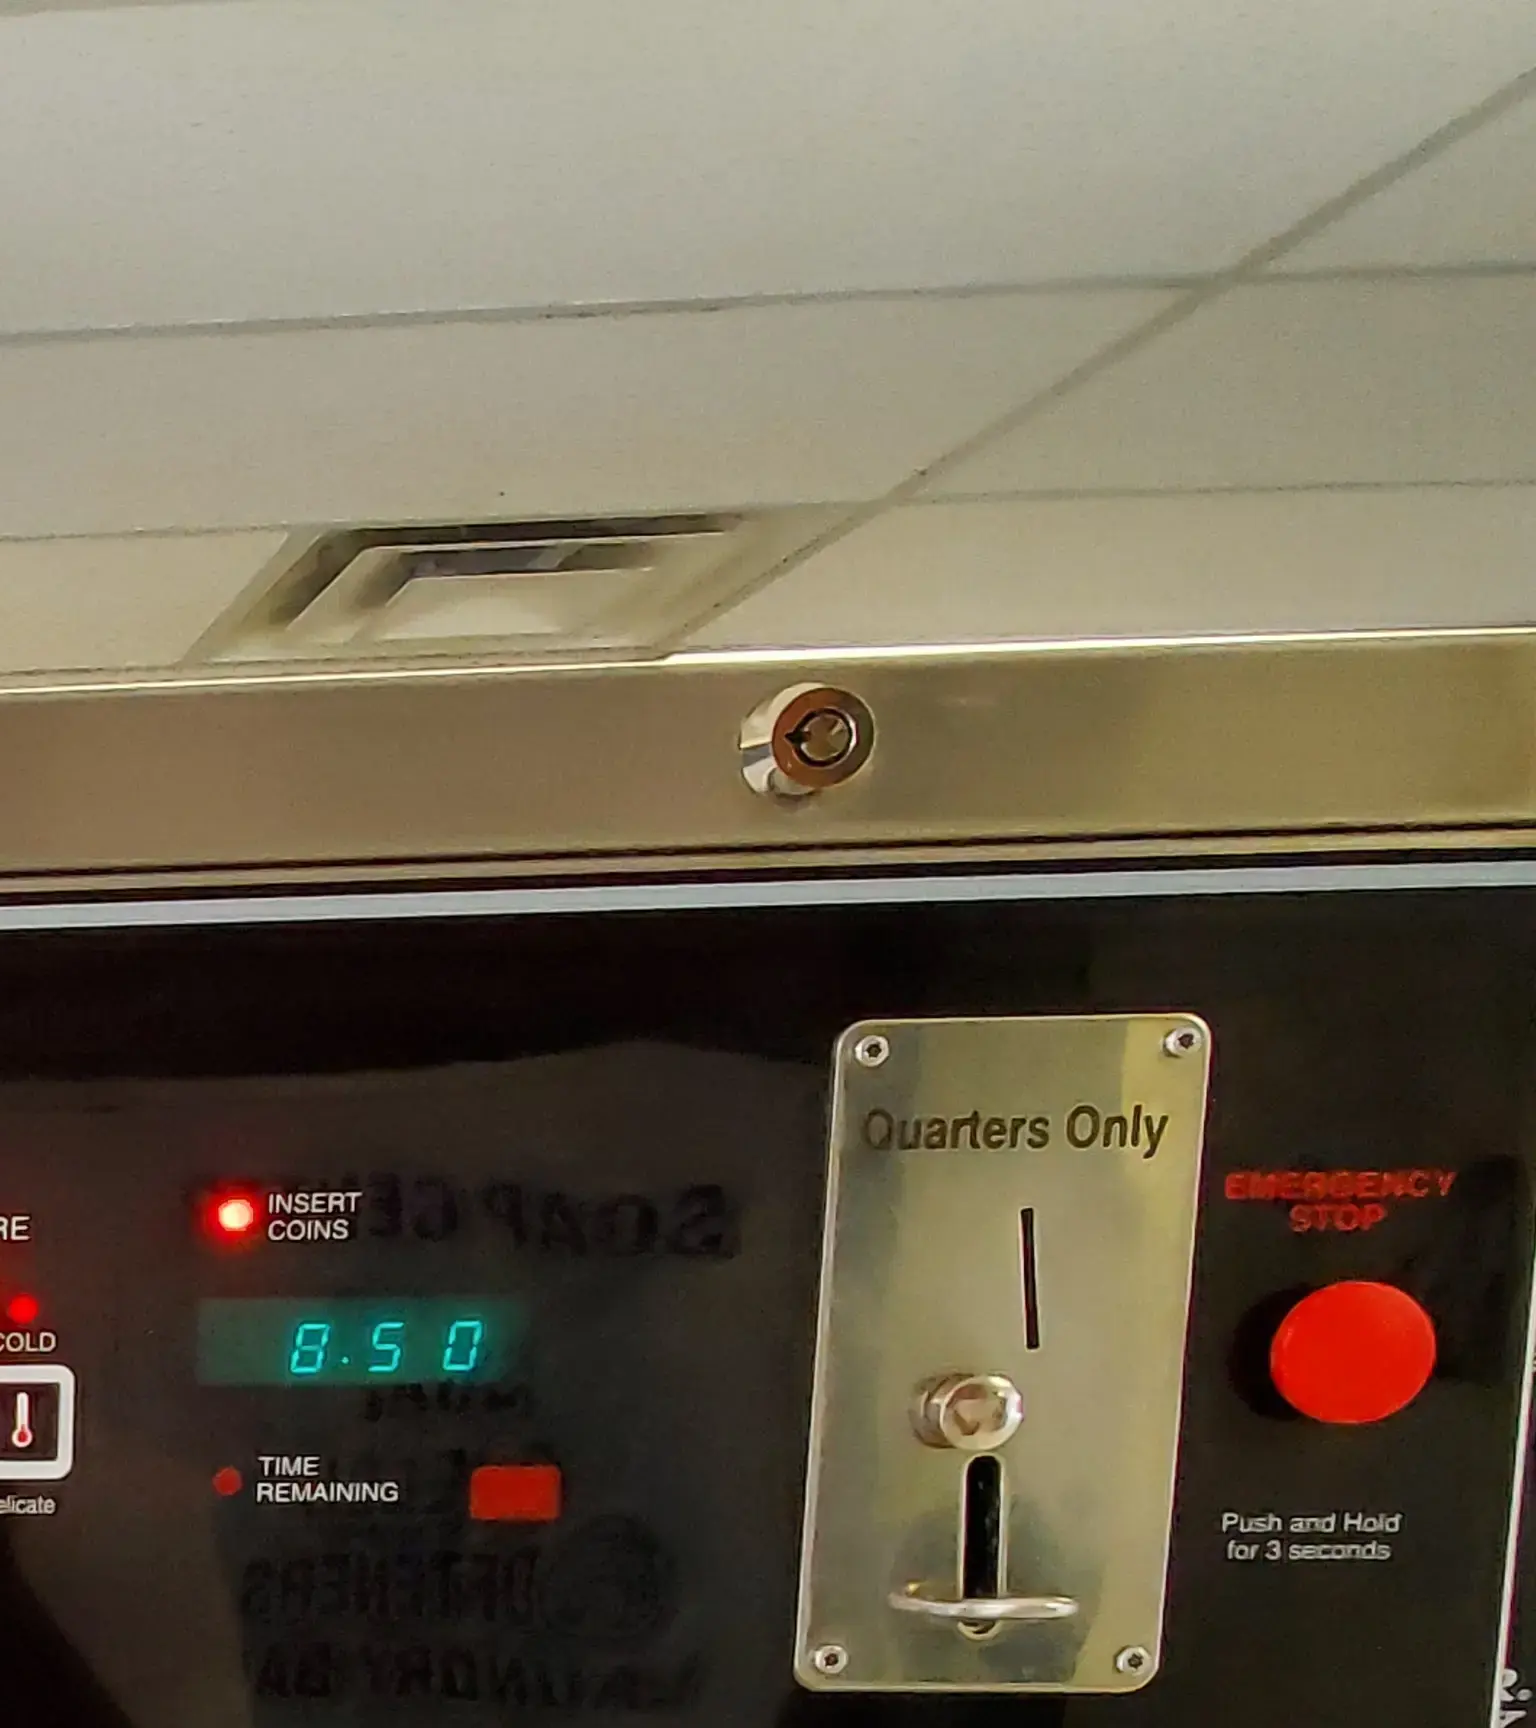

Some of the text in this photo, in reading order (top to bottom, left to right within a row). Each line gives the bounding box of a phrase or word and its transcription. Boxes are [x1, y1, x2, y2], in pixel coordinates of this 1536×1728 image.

[861, 1104, 1171, 1159] Quarters Only
[1224, 1171, 1457, 1199] EMERGENCY
[267, 1191, 362, 1214] INSERT
[1289, 1203, 1386, 1233] STOP
[267, 1219, 350, 1242] COINS
[258, 1455, 321, 1477] TIME
[256, 1480, 400, 1503] REMAINING
[1222, 1511, 1403, 1534] Push and Hold
[1228, 1539, 1392, 1561] for 3 seconds
